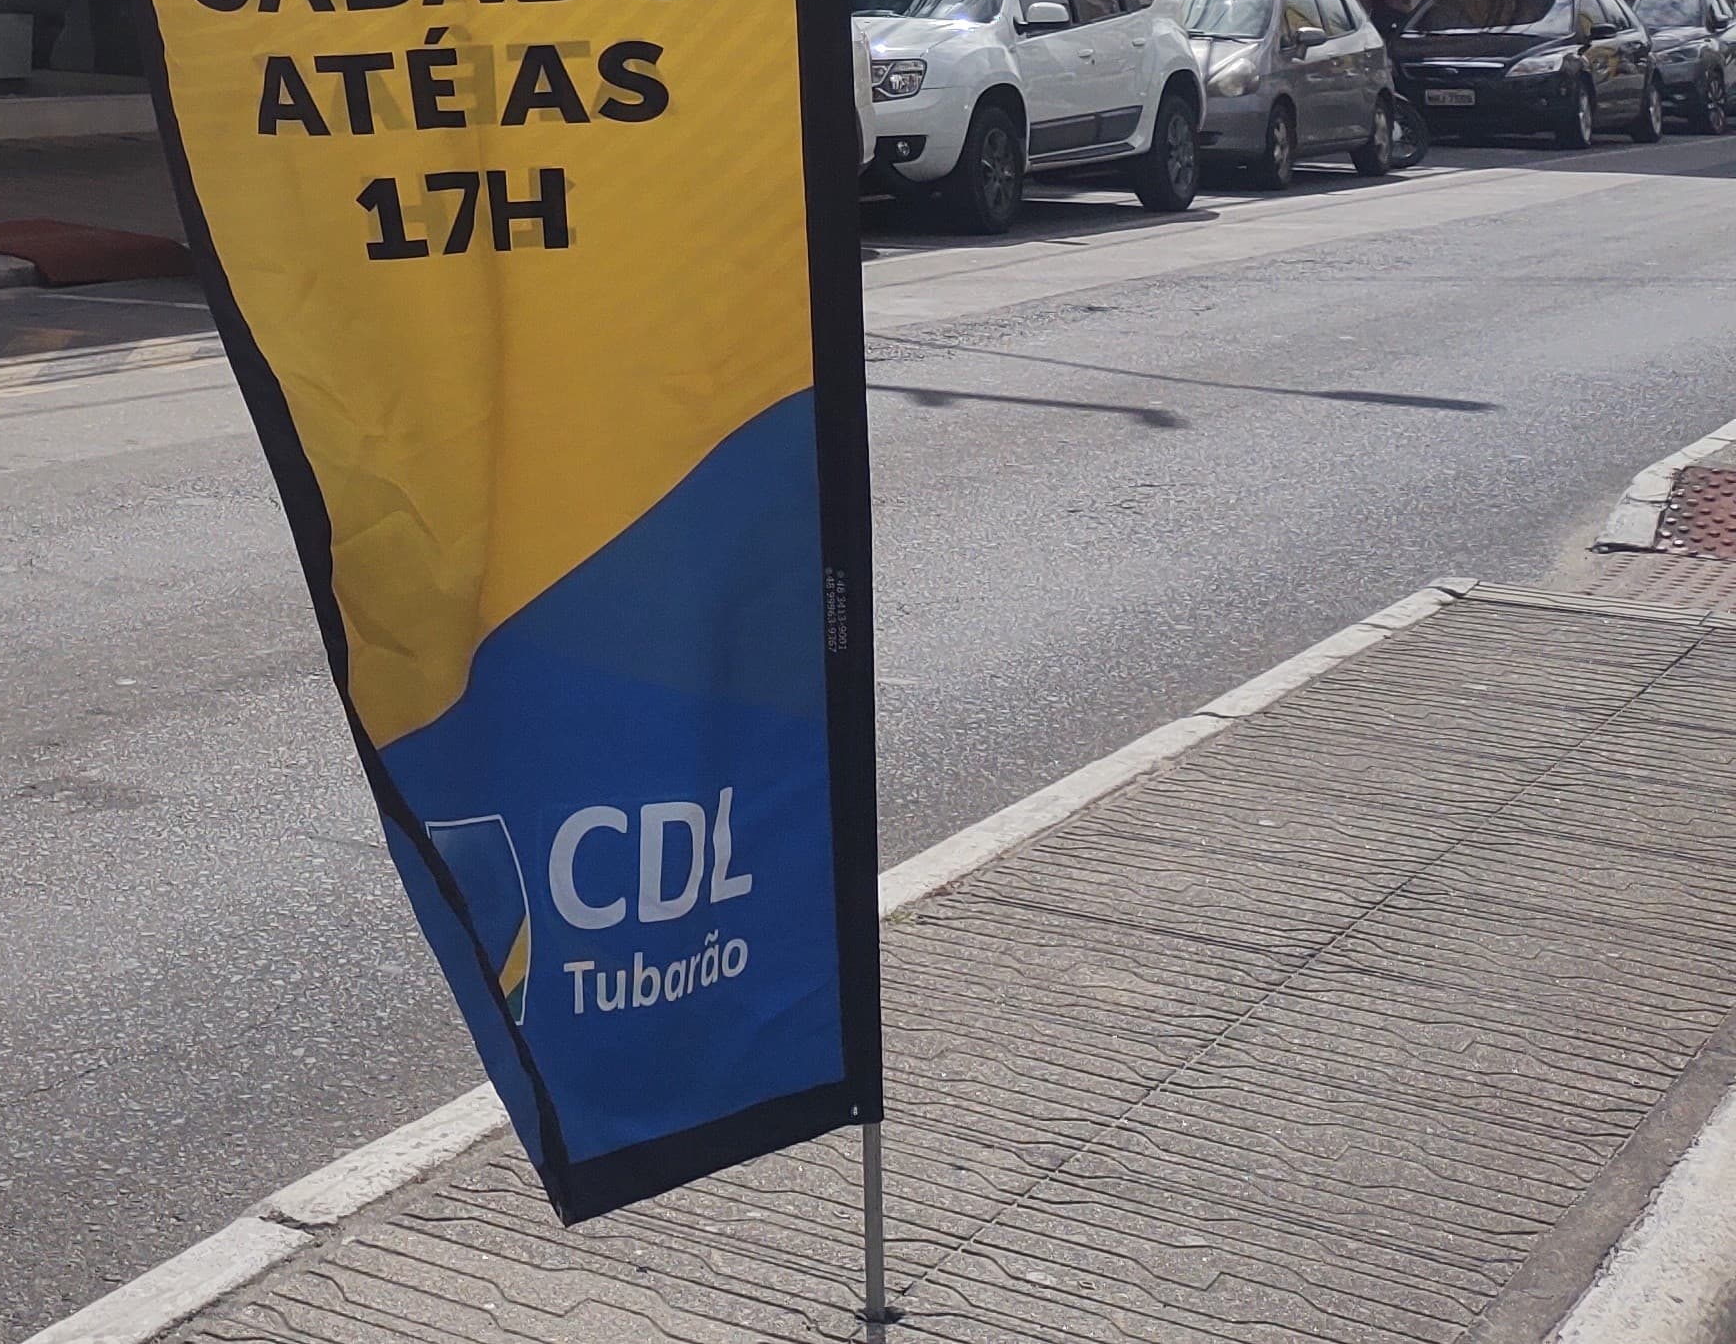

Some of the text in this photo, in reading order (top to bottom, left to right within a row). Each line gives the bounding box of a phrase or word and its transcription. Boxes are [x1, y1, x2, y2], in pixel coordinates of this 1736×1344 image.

[257, 27, 669, 136] ATÉ AS
[356, 168, 570, 261] 17H
[548, 787, 752, 929] CDL
[563, 929, 749, 1015] Tubarão
